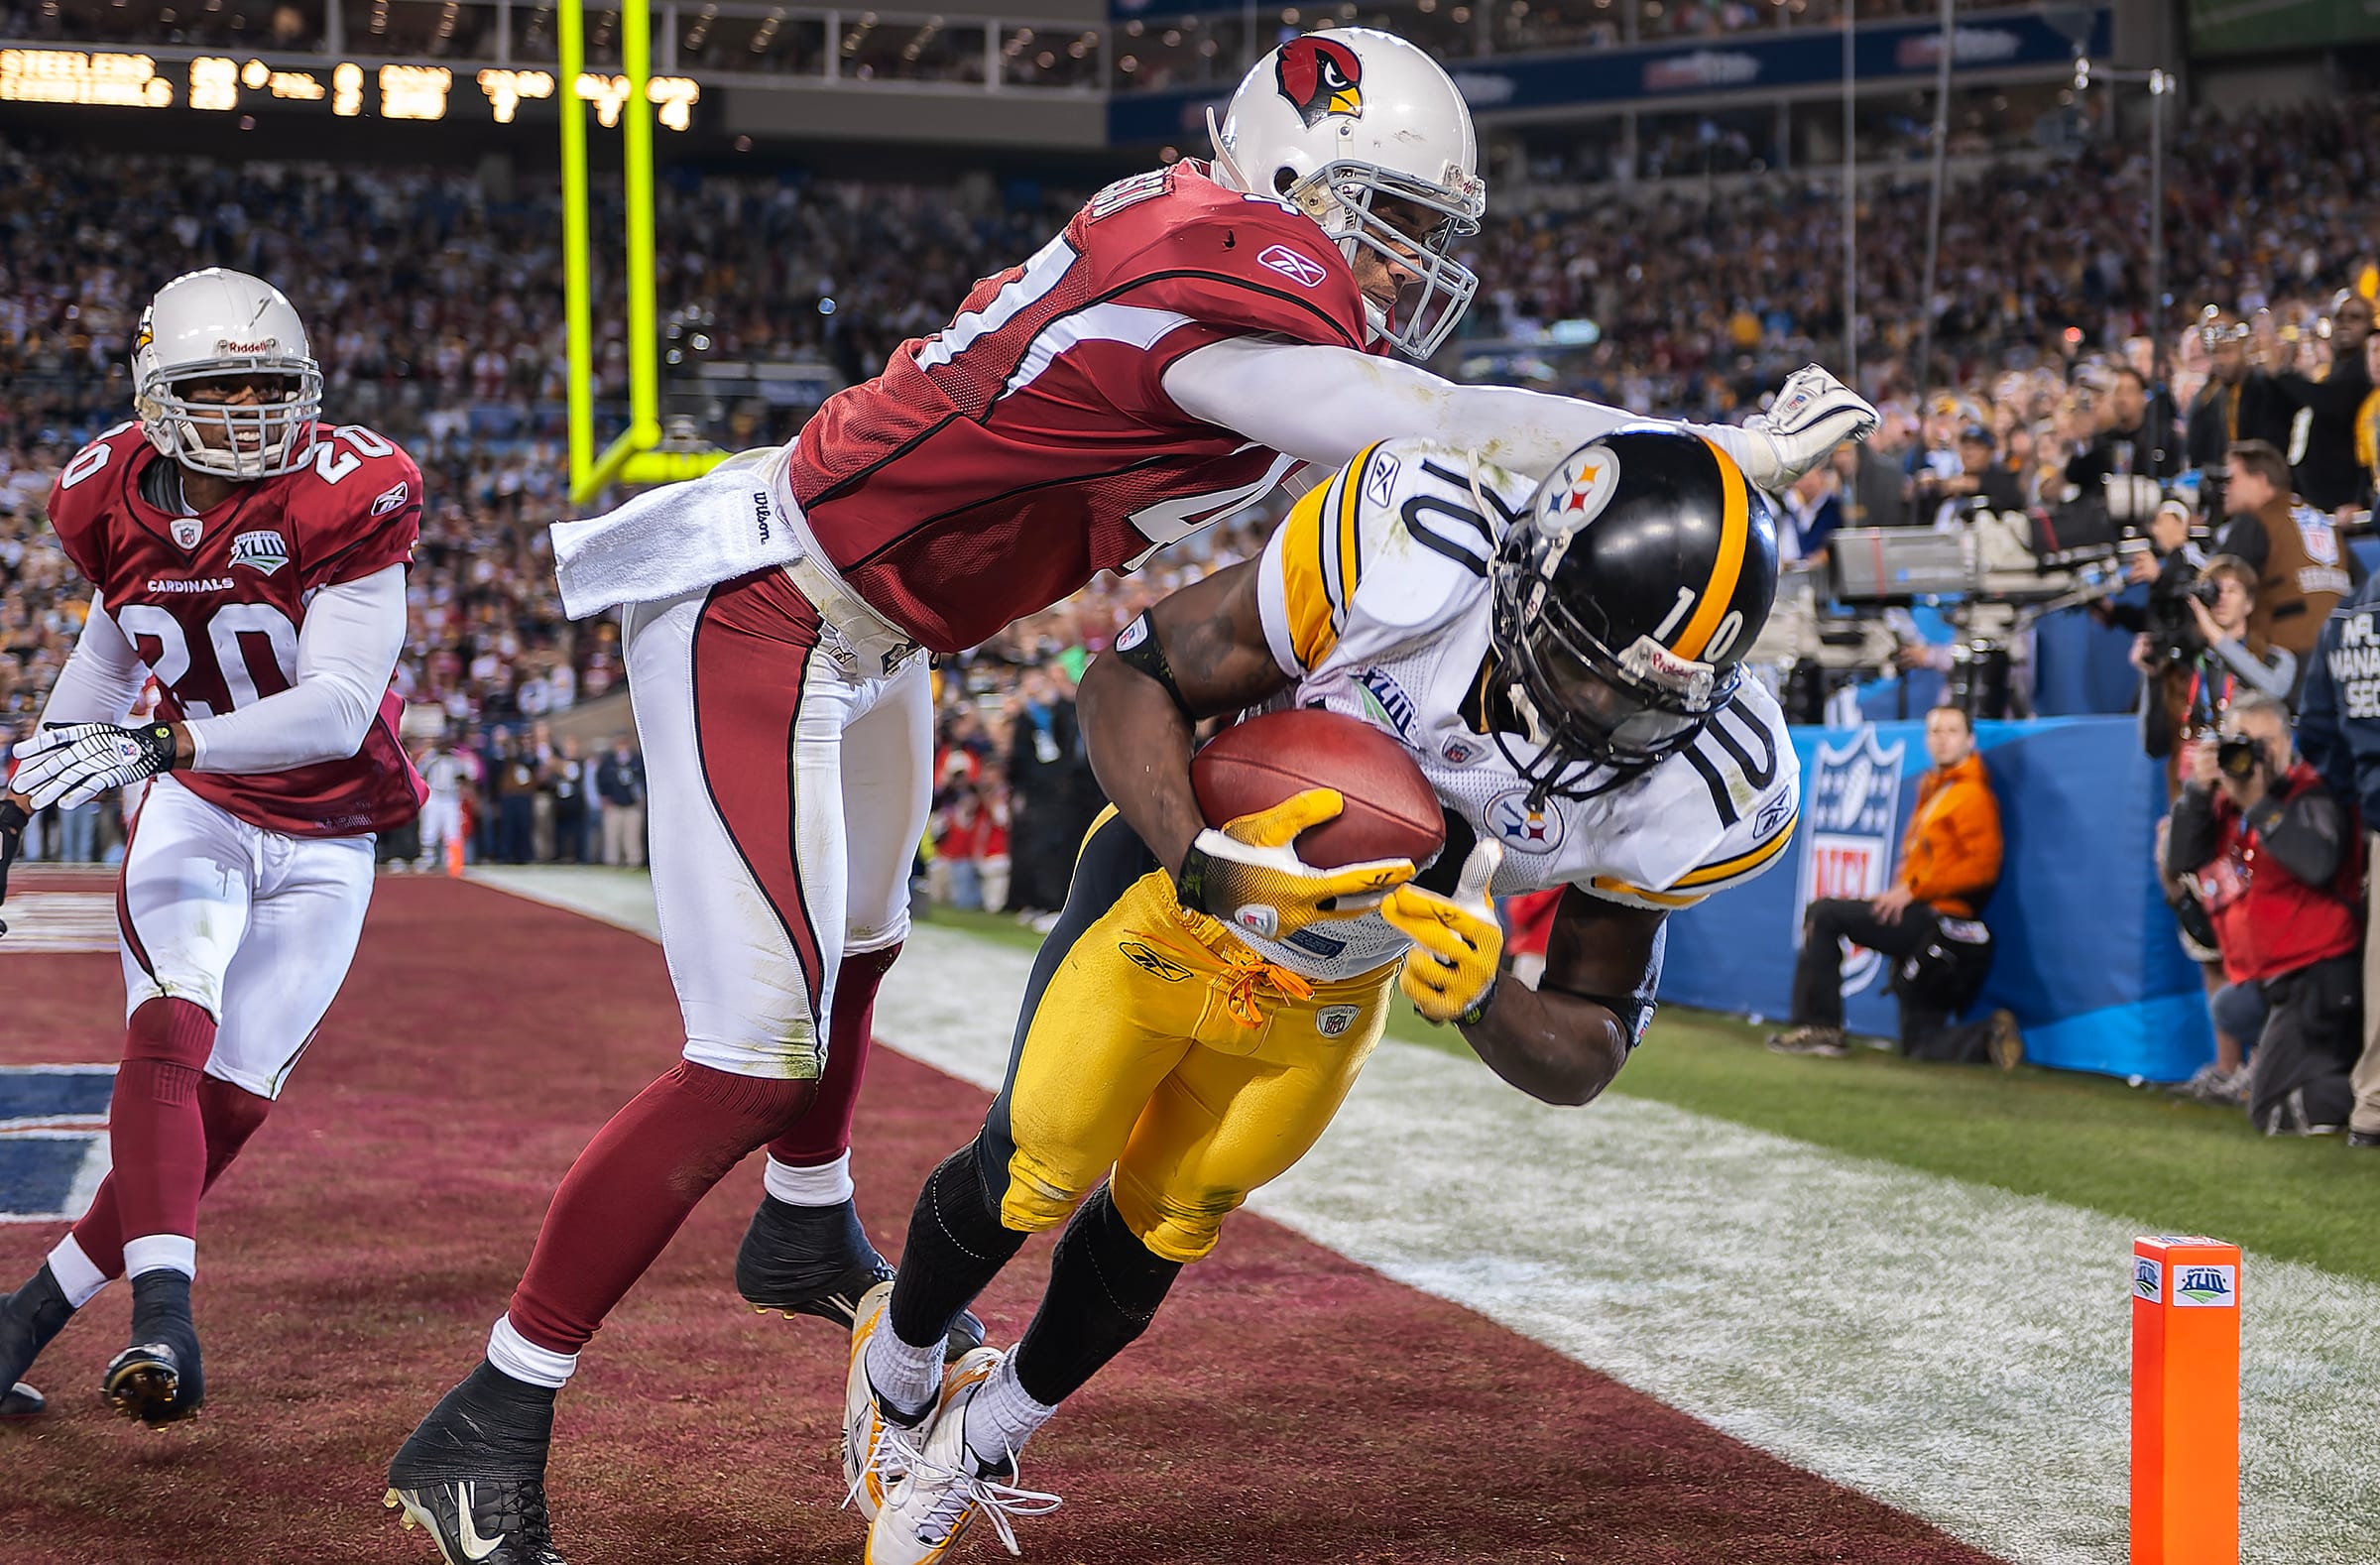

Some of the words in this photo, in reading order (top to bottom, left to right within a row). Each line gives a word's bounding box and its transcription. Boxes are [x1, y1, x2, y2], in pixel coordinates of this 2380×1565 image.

[236, 539, 286, 560] XLIII
[753, 491, 771, 543] Wilson
[1400, 457, 1521, 578] 10
[147, 577, 235, 593] CARDINALS
[117, 603, 298, 721] 20
[1682, 694, 1778, 830] 10
